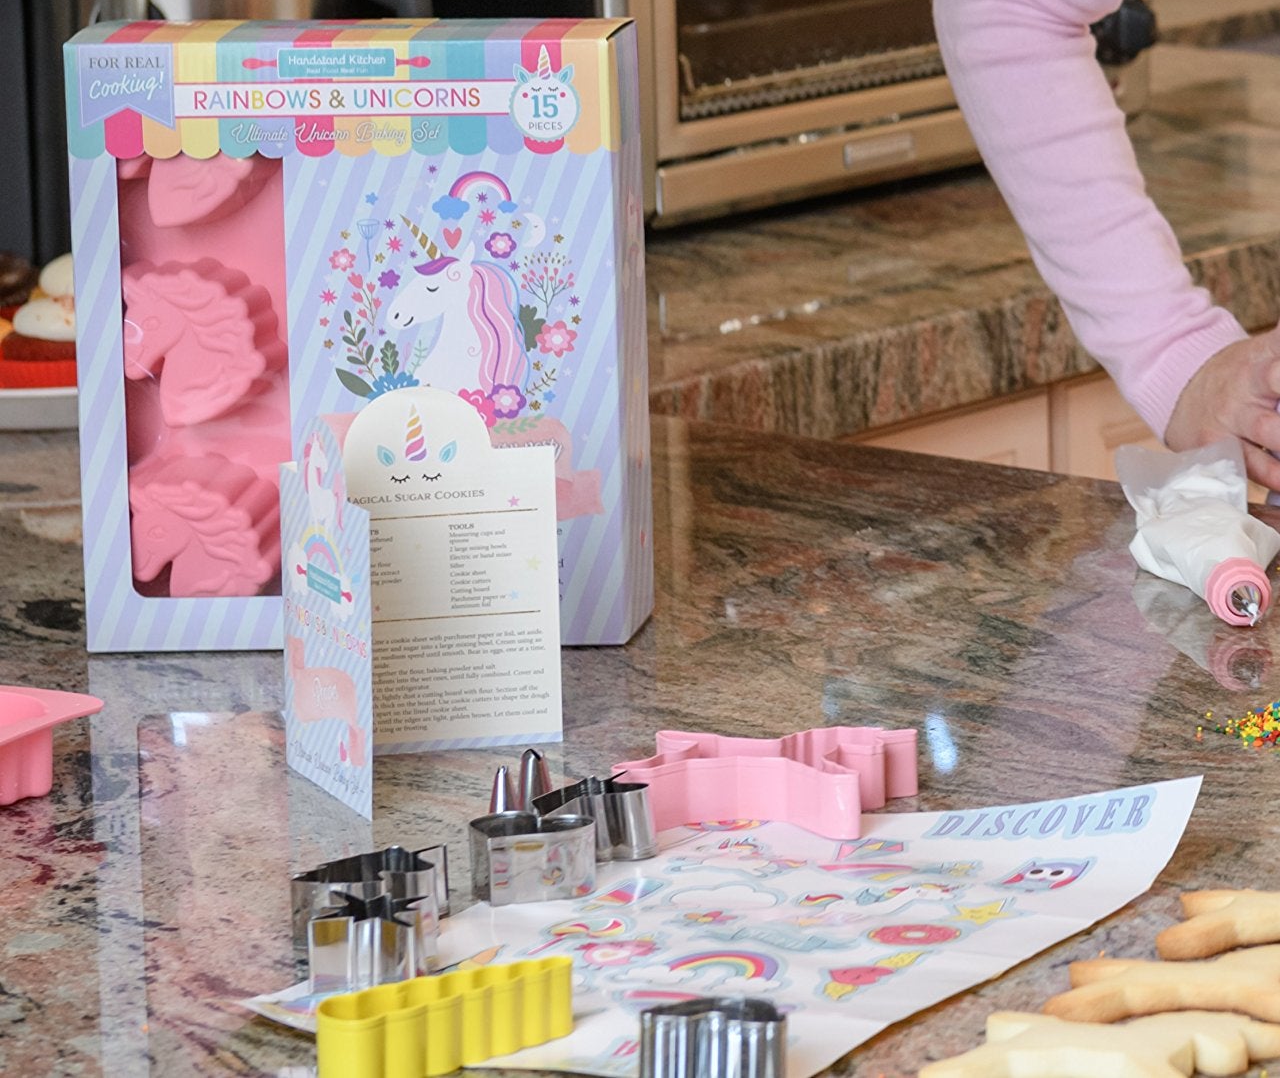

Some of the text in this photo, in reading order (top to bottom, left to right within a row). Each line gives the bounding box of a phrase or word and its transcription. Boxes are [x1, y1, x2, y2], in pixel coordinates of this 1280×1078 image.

[89, 57, 164, 69] FOR REAL
[289, 55, 385, 65] Handstand Kitchen
[90, 71, 163, 100] Cooking!
[194, 89, 480, 110] RAINBOWS & UNICORNS
[531, 94, 558, 118] 15
[232, 121, 441, 145] Ultimate Unicorn Baking Set
[529, 122, 563, 130] PIECES
[395, 493, 430, 502] SUGAR
[435, 490, 485, 500] COOKIES
[932, 794, 1152, 837] DISCOVER
